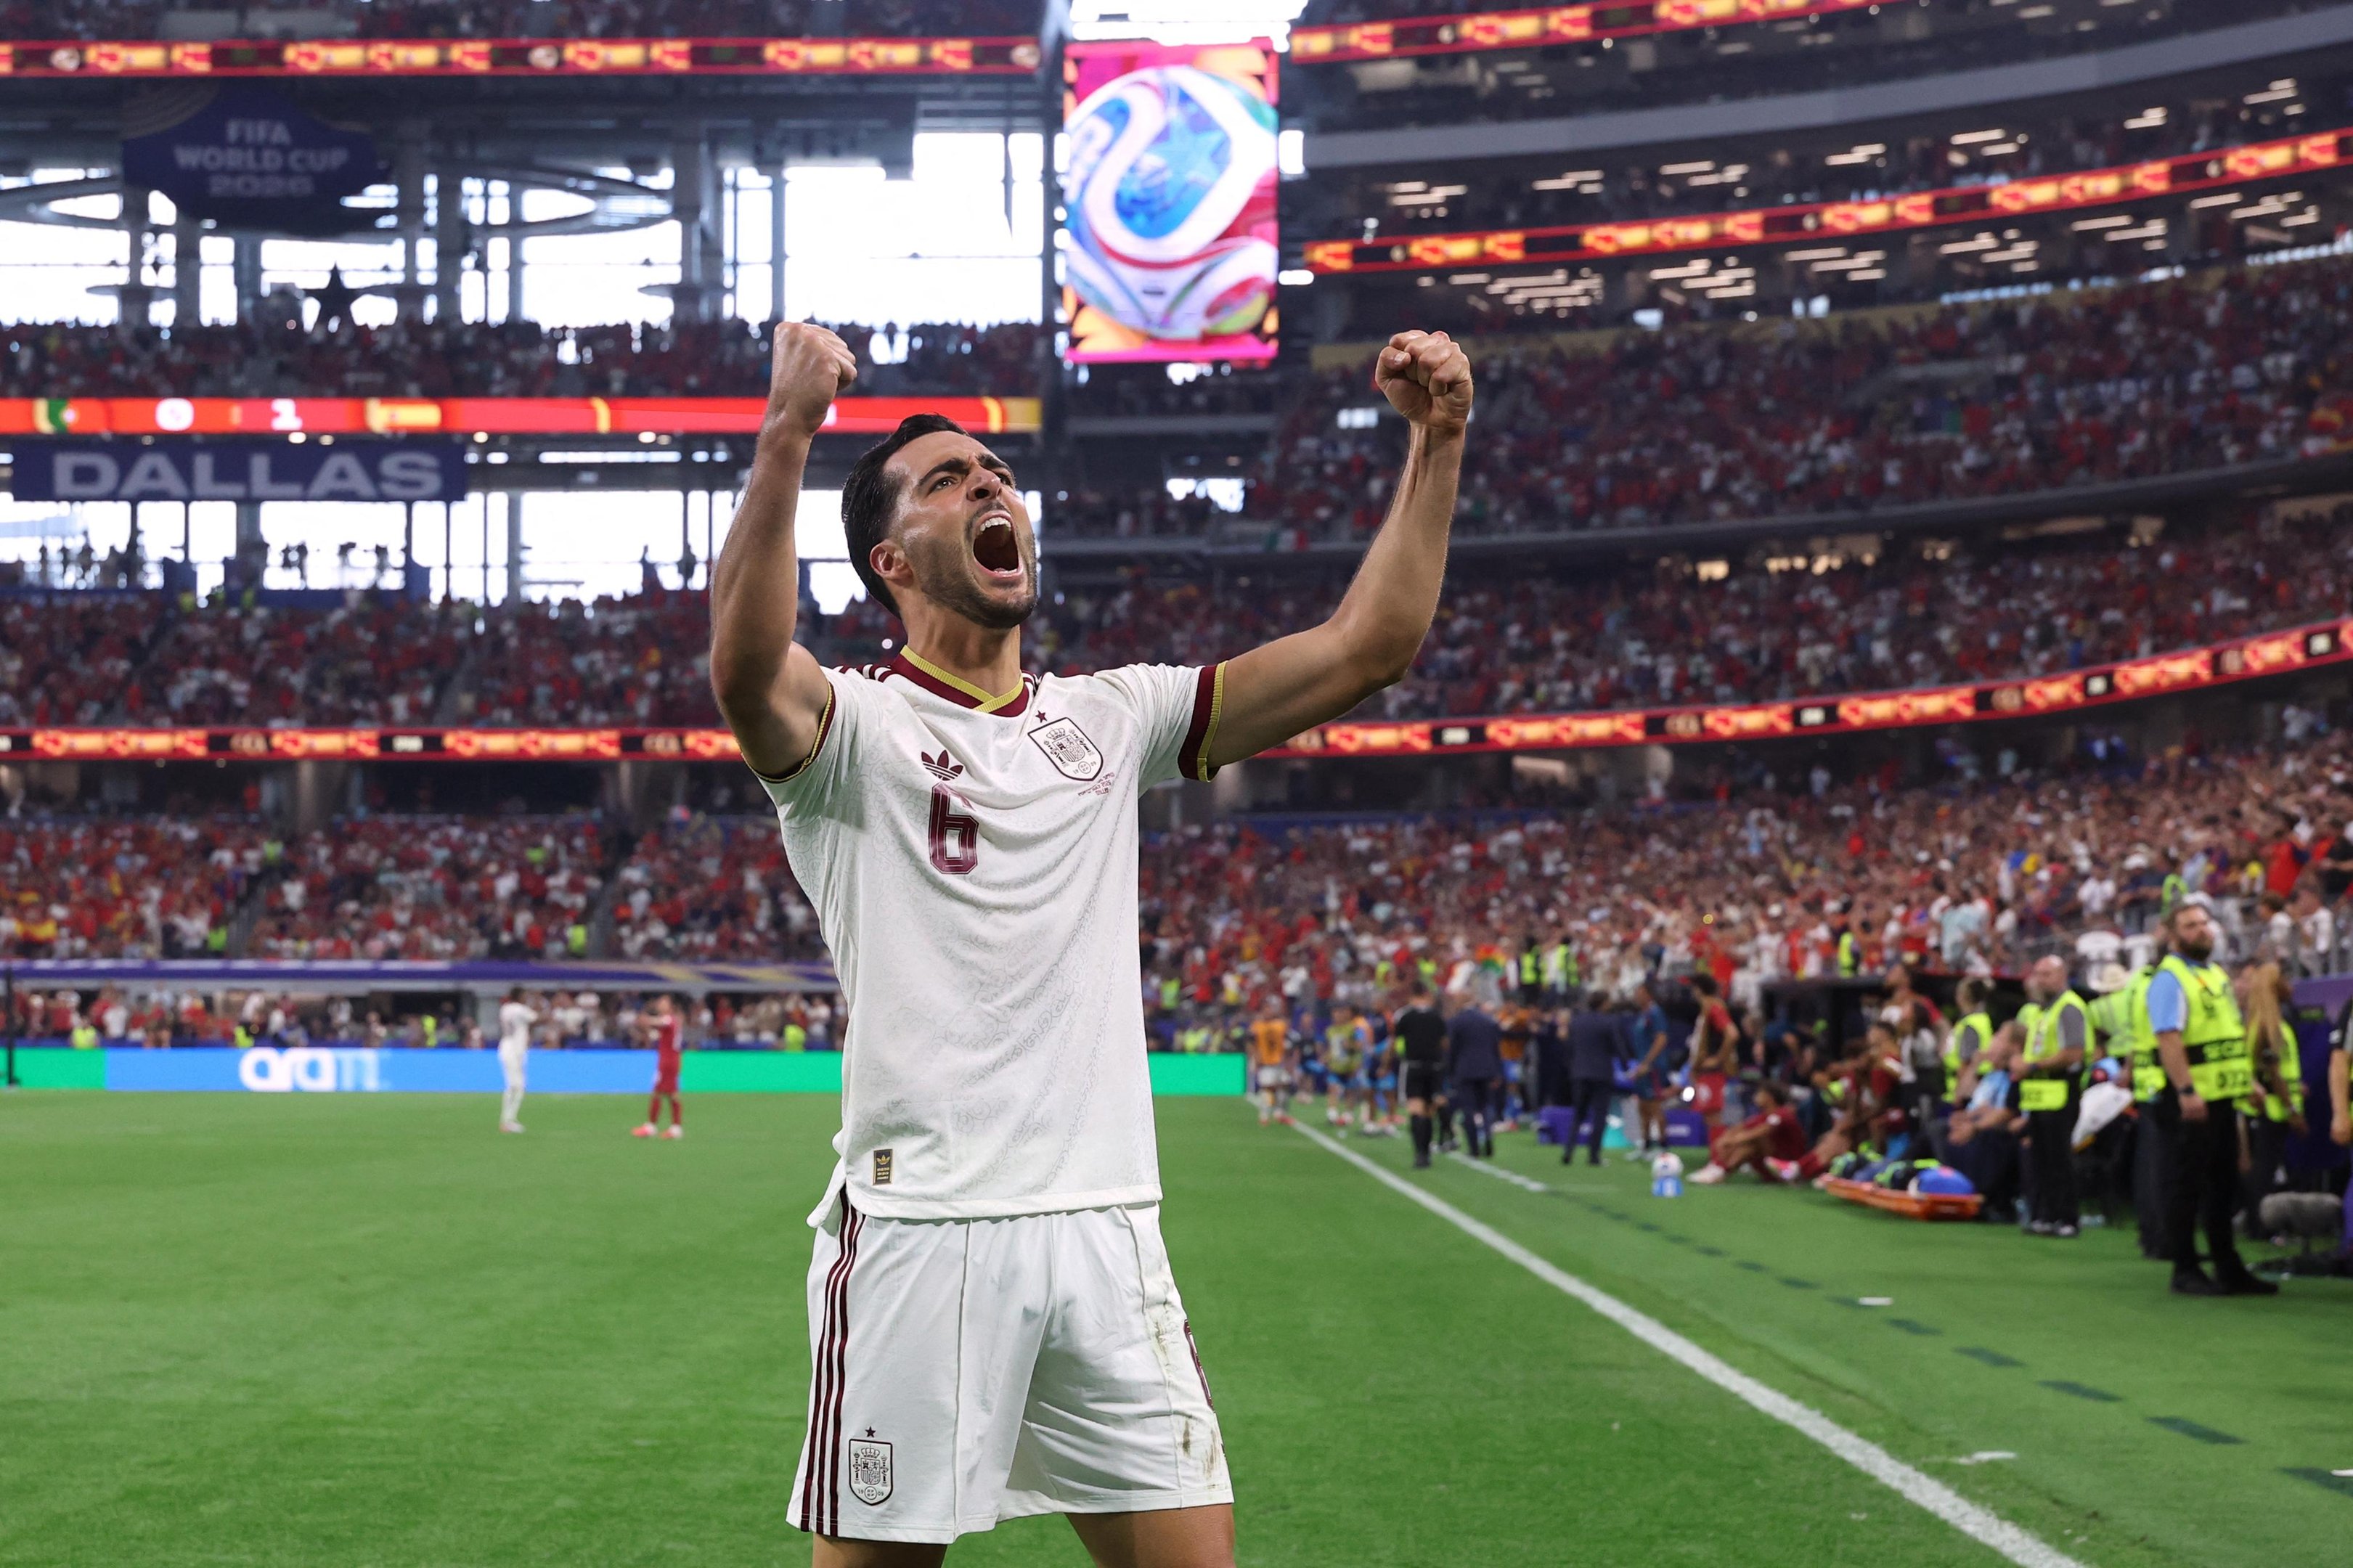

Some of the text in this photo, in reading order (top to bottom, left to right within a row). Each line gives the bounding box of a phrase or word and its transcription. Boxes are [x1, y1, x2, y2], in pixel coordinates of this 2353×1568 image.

[227, 118, 291, 144] FIFA
[174, 147, 349, 171] WORLD CUP
[53, 451, 442, 499] DALLAS
[929, 782, 979, 874] 6
